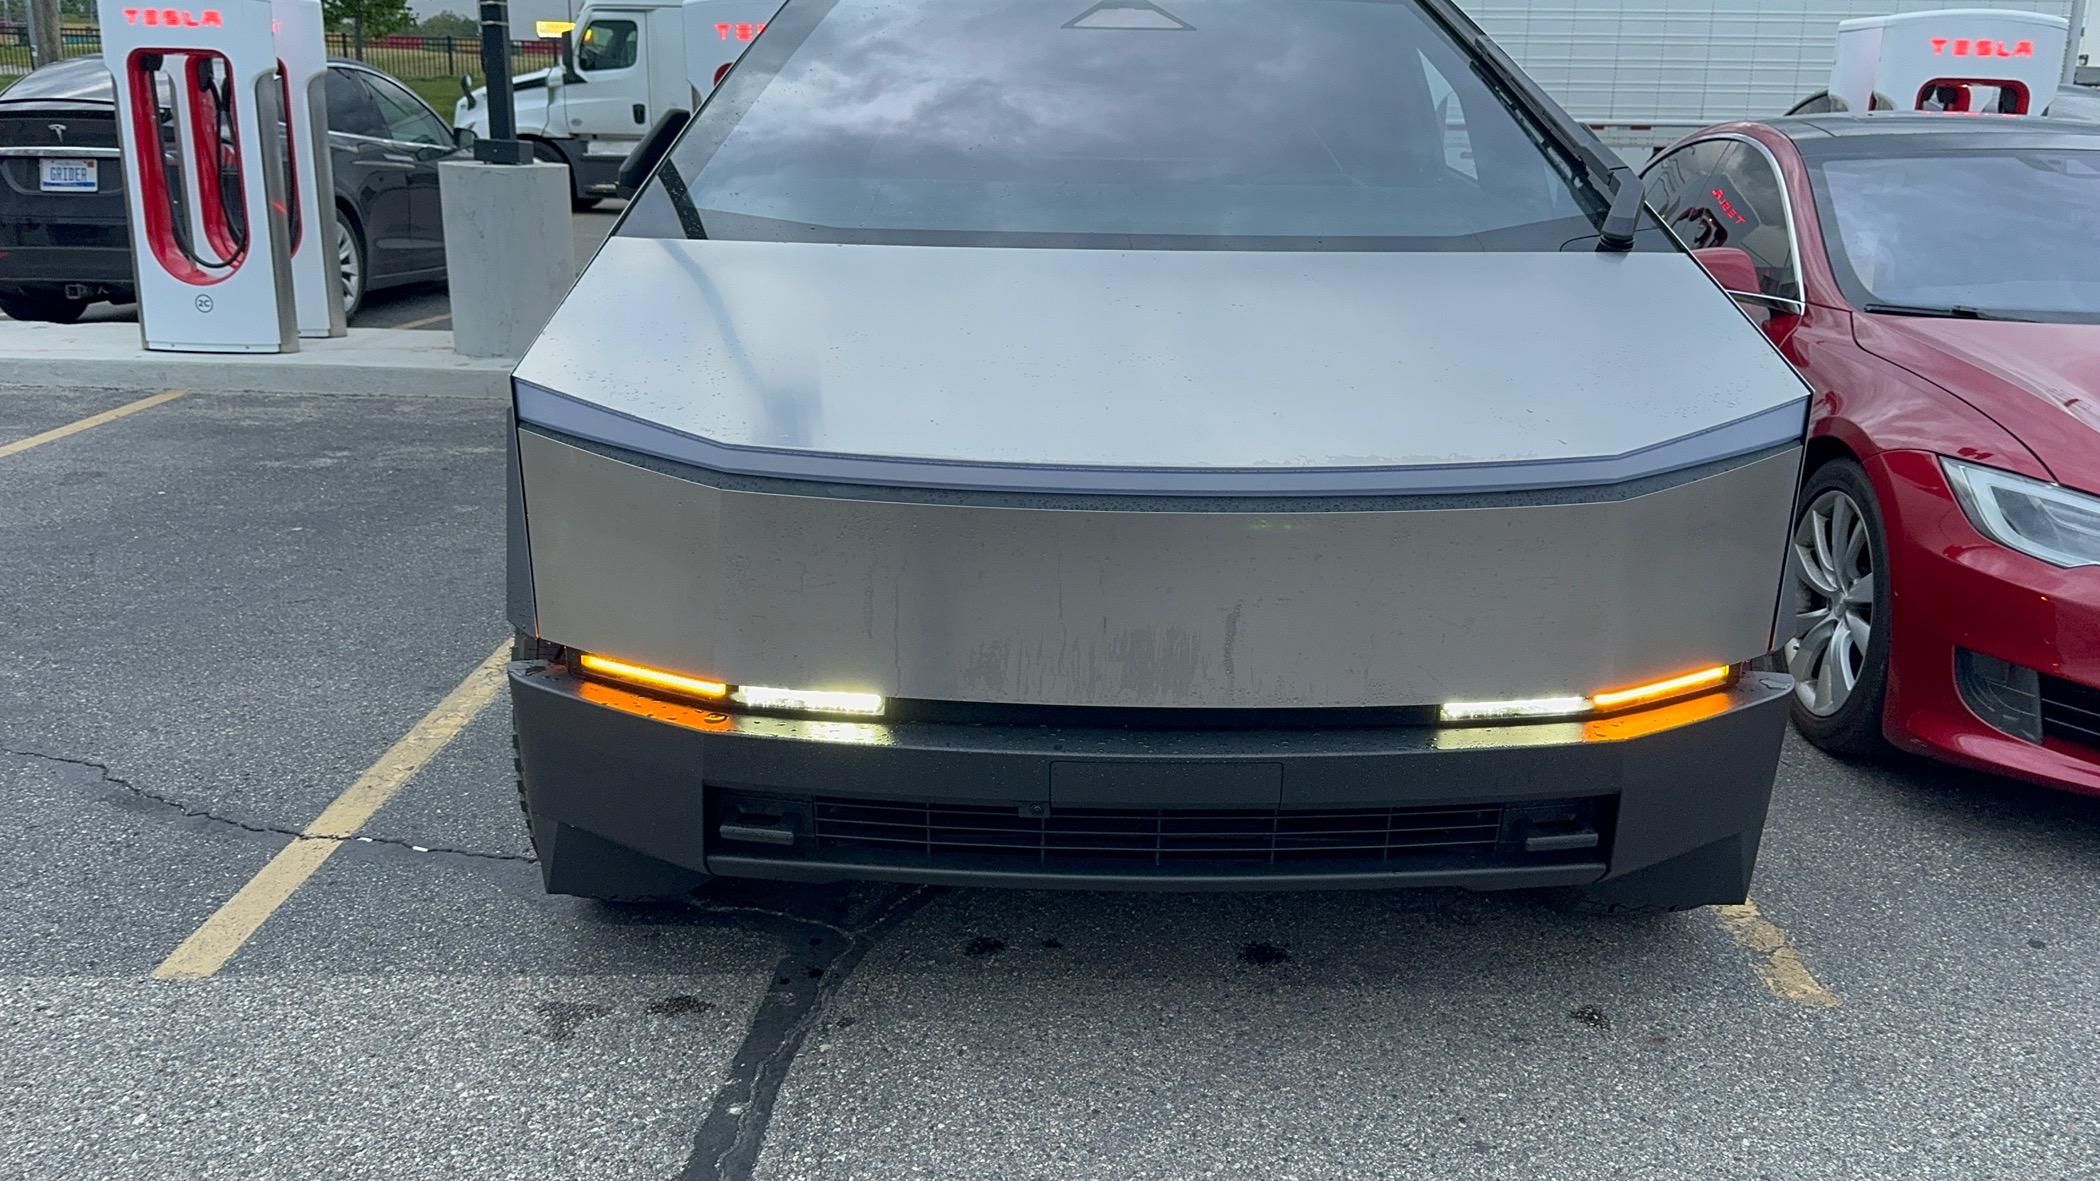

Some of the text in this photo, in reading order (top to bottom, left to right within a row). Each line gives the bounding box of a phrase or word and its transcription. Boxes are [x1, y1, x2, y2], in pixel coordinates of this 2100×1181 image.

[122, 9, 223, 28] TESLA
[1930, 37, 2034, 58] TESLA
[50, 167, 88, 181] GRIDER
[198, 299, 210, 308] 2C
